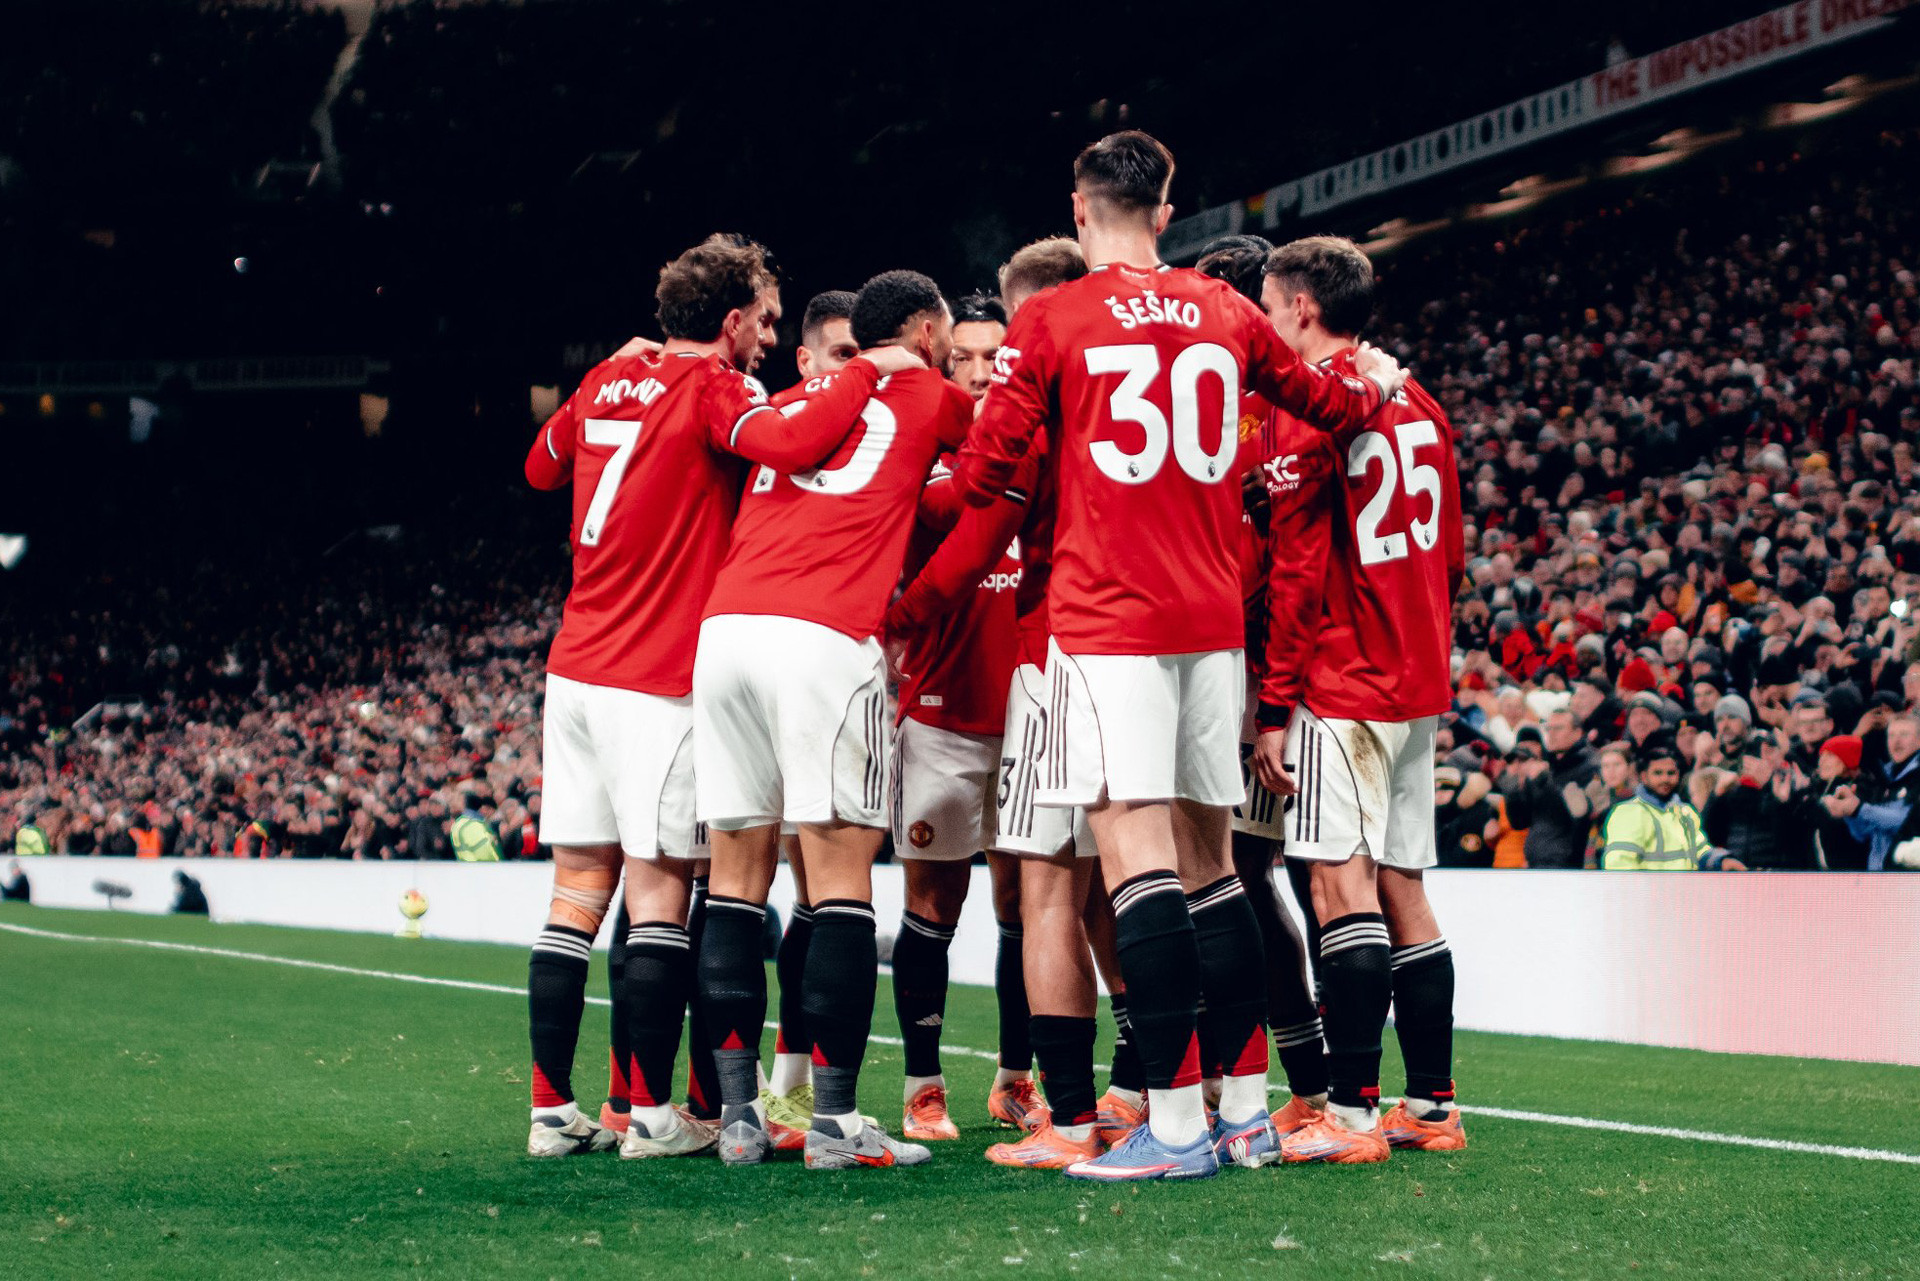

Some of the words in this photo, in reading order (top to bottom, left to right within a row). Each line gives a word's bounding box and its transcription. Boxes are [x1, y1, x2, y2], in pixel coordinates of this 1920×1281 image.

[1592, 57, 1640, 106] THE
[1650, 2, 1808, 90] IMPOSSIBLE
[1104, 289, 1200, 329] ŠEŠKO
[593, 377, 668, 406] MONT
[1084, 342, 1239, 484] 30
[580, 418, 642, 546] 7
[1348, 420, 1441, 565] 25
[978, 567, 1022, 593] apd
